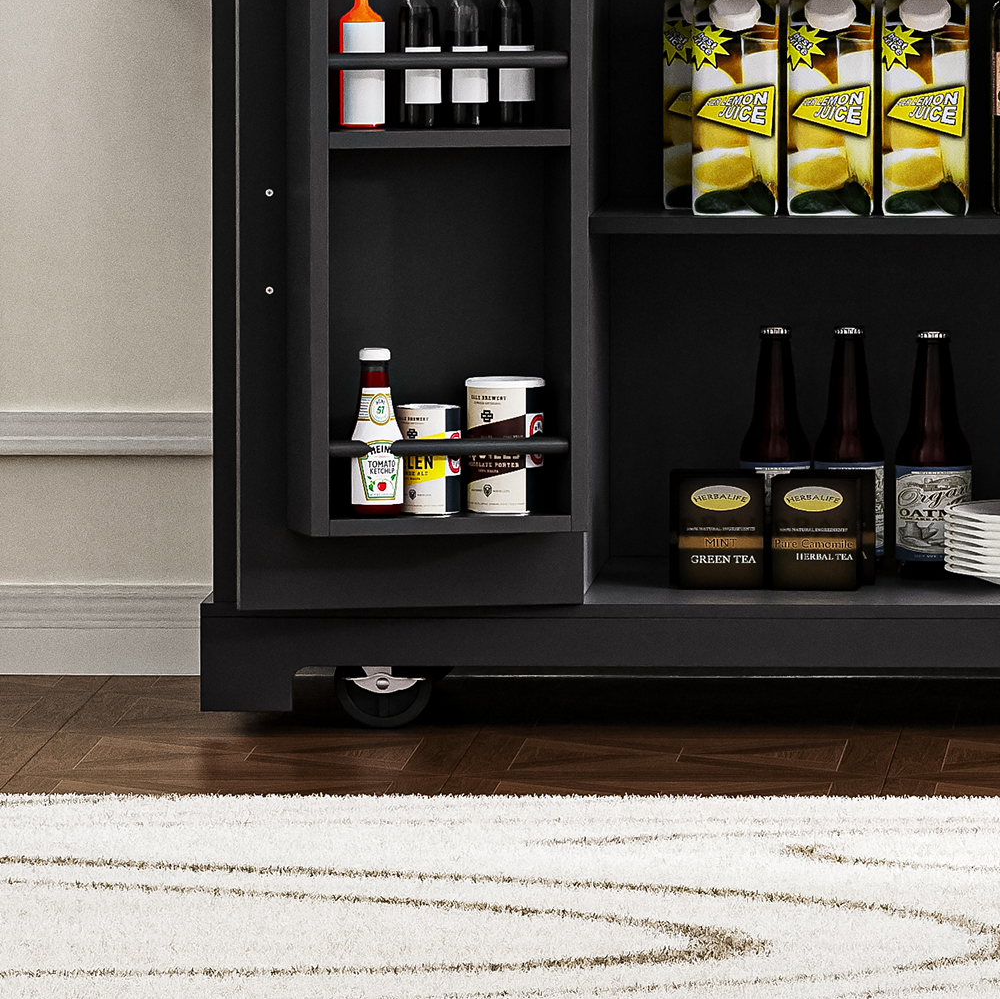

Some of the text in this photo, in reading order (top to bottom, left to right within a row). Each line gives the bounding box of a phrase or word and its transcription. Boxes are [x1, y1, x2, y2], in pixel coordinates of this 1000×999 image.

[720, 91, 769, 106] LEMON
[815, 91, 864, 106] LEMON
[910, 91, 959, 106] LEMON
[718, 105, 767, 125] JUICE
[813, 105, 862, 125] JUICE
[908, 105, 957, 125] JUICE
[376, 405, 386, 414] 57
[368, 460, 396, 468] TOMATO
[369, 467, 395, 475] KETCHUP
[693, 493, 748, 503] HERBALIFE
[786, 494, 841, 504] HERBALIFE
[705, 538, 737, 547] MINT
[774, 538, 853, 549] Pure Camomile
[690, 554, 757, 564] GREEN TEA
[796, 553, 854, 561] HERBAL TEA
